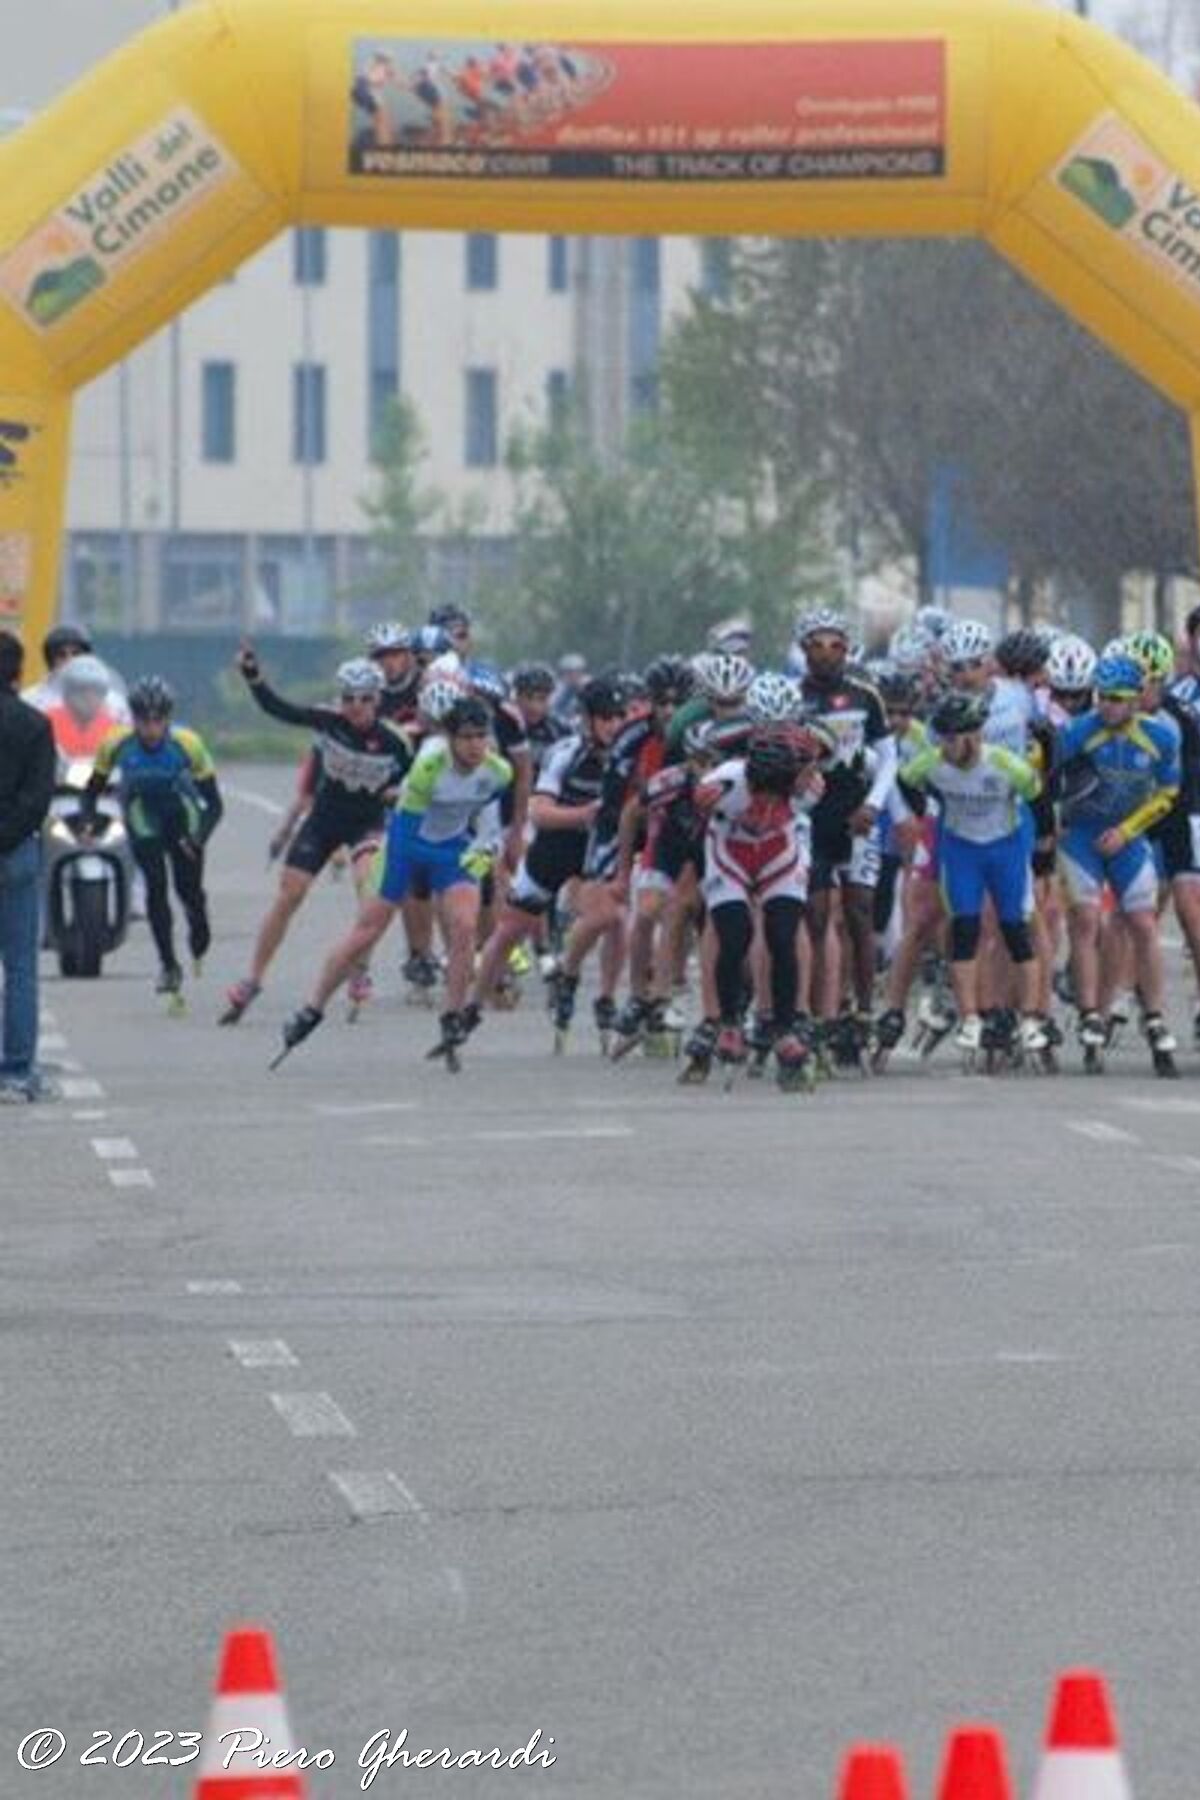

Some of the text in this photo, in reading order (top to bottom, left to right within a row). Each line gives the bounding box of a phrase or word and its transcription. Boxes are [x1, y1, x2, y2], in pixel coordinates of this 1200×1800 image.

[65, 152, 149, 225] Valli
[612, 150, 939, 175] THE TRACK OF CHAMPIONS
[91, 145, 222, 254] Cimone
